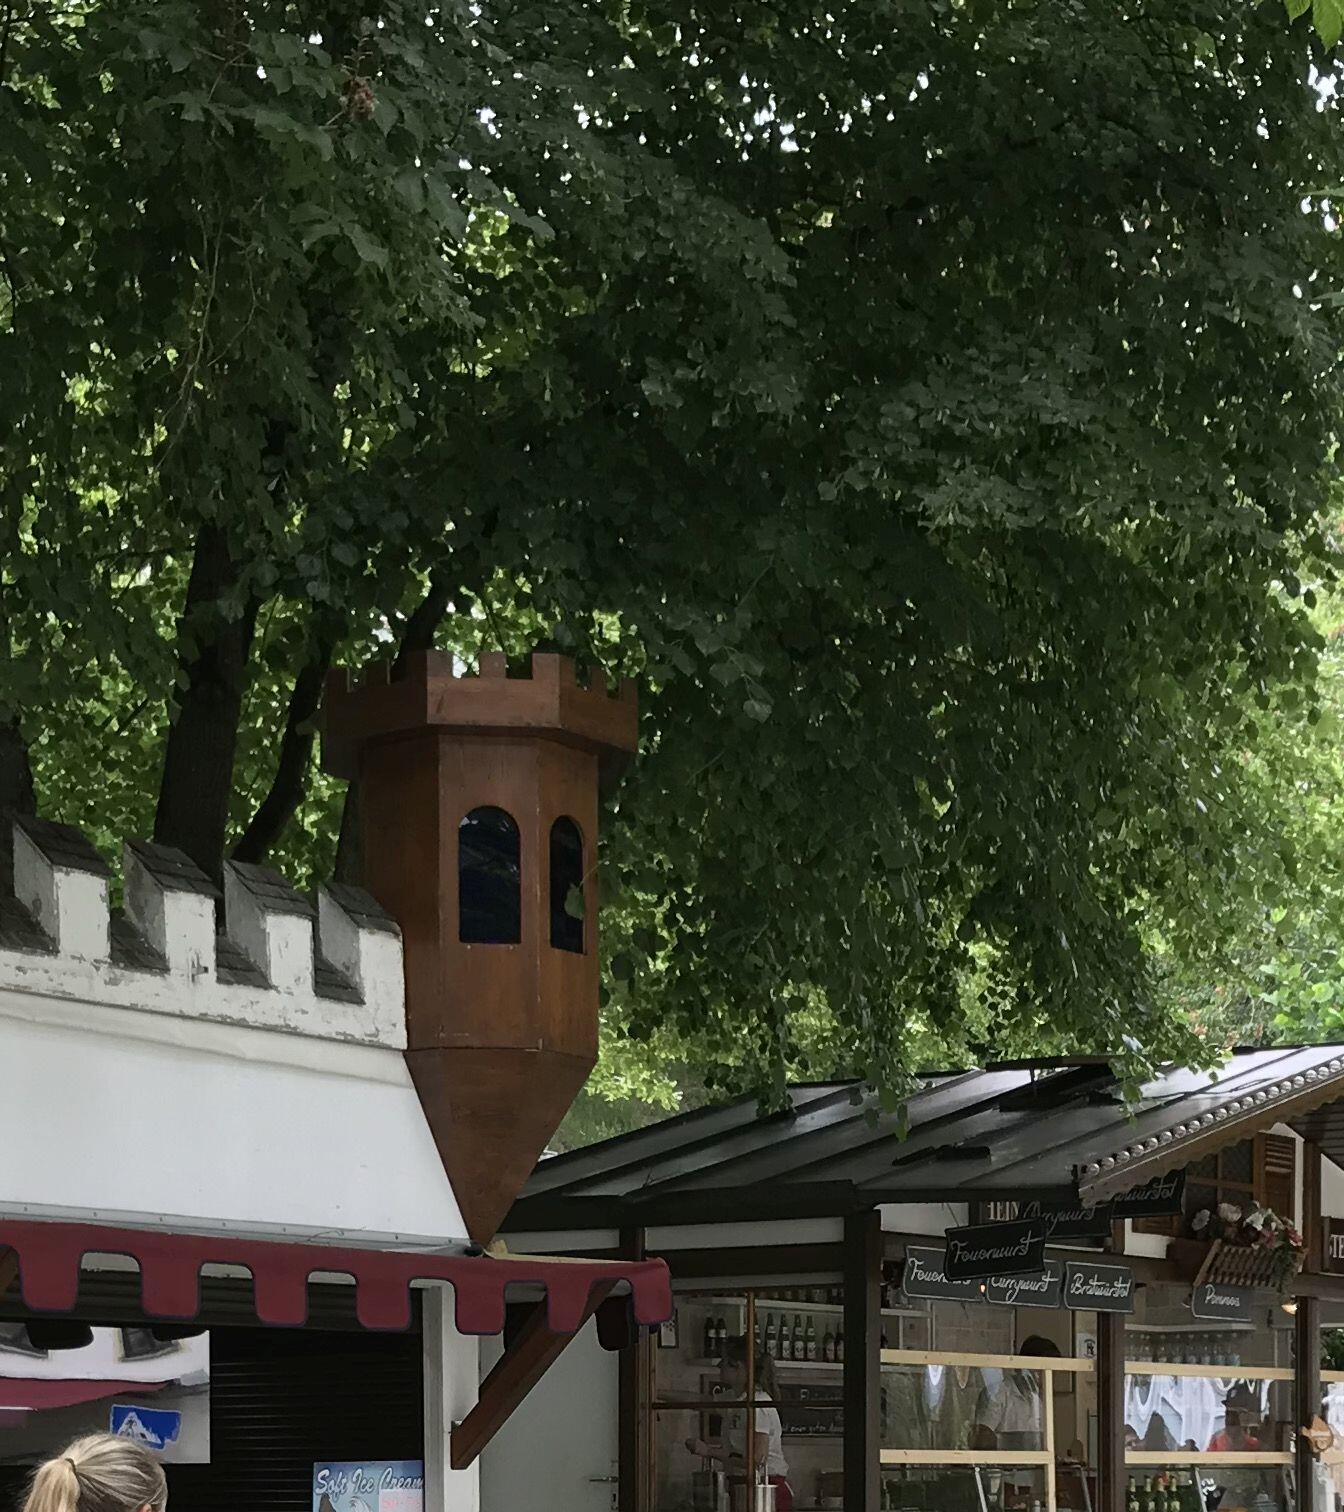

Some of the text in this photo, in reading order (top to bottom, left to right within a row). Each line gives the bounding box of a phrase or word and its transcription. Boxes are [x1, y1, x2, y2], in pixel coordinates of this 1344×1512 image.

[951, 1230, 1044, 1264] Feuerwurst
[316, 1468, 347, 1498] Soft
[353, 1468, 374, 1493] Ice
